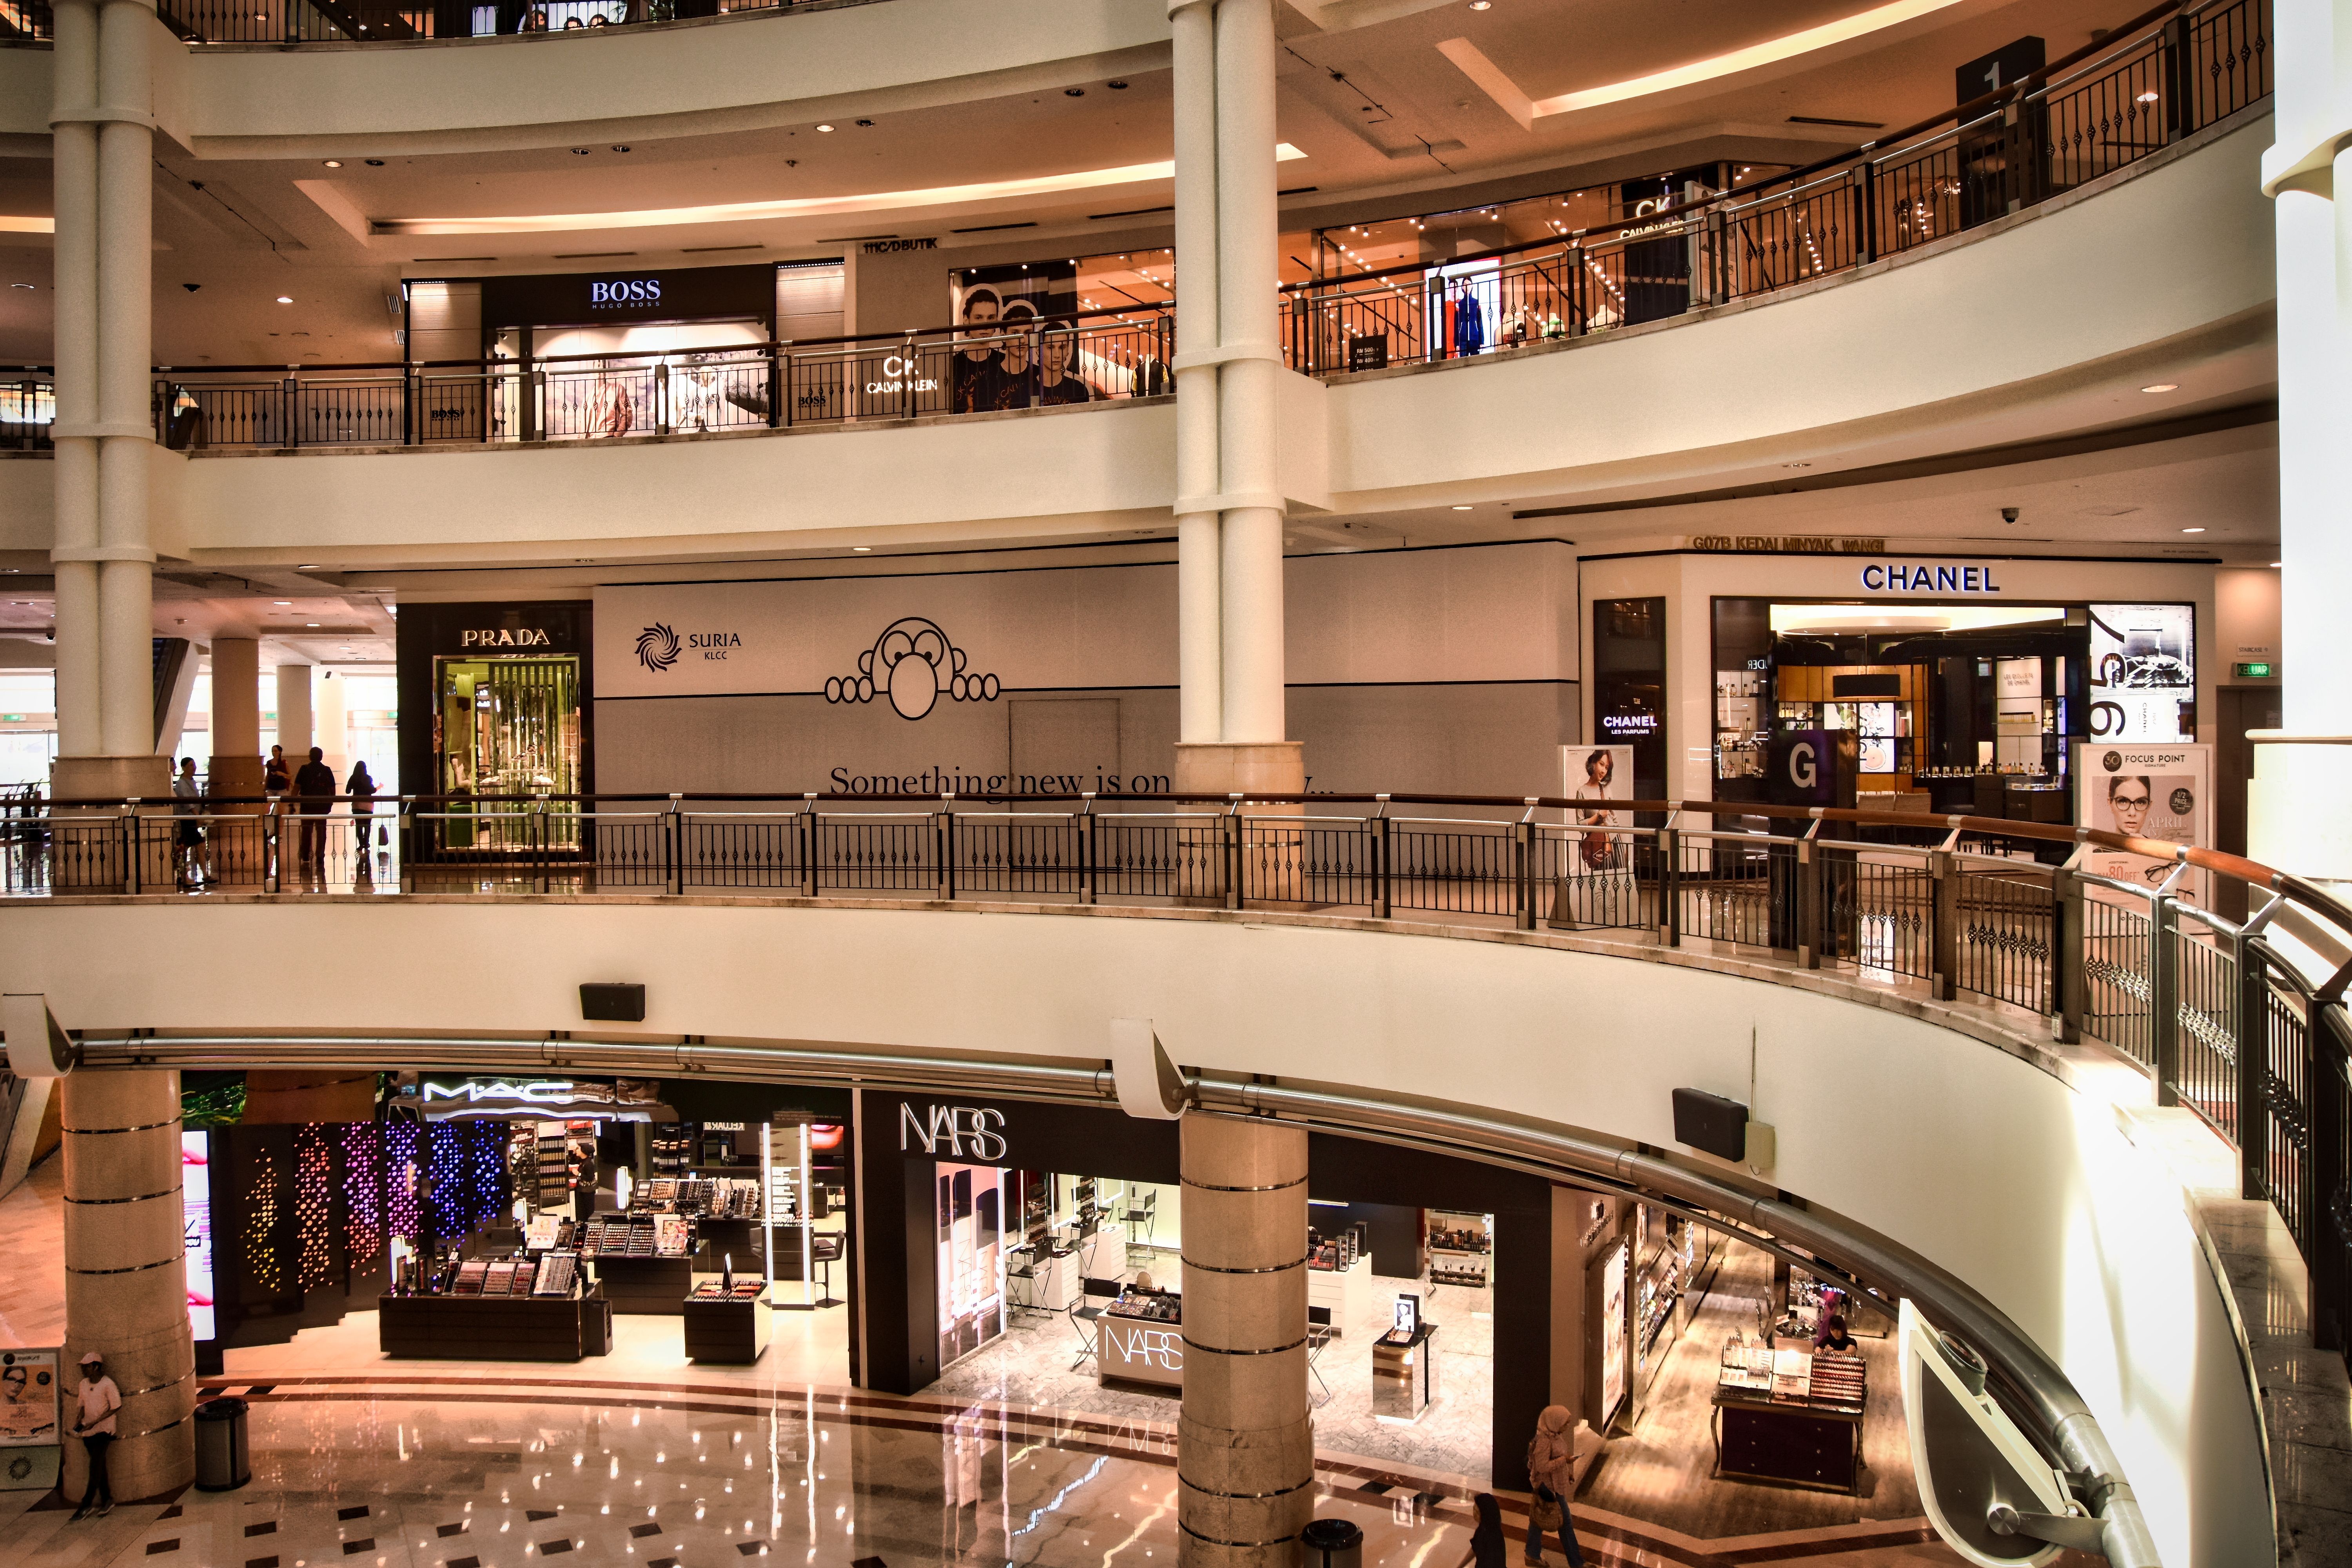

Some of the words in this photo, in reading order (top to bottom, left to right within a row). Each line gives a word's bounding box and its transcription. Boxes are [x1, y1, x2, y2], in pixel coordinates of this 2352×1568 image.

[1984, 61, 2000, 104] 1
[592, 280, 661, 302] BOSS
[867, 381, 903, 394] CALVIN
[798, 396, 826, 405] BOSS
[432, 410, 460, 418] BOSS
[1693, 536, 1731, 550] G07B
[1736, 537, 1779, 550] KEDAI
[1782, 537, 1836, 552] MINYAK
[1842, 539, 1885, 553] WANGI
[1862, 564, 2000, 592] CHANEL
[461, 628, 550, 646] PRADA
[689, 633, 742, 648] SURIA
[705, 651, 728, 660] KLCC
[2238, 665, 2268, 675] KELUAR
[1603, 716, 1658, 727] CHANEL
[1789, 742, 1816, 788] G
[831, 766, 1007, 804] Something
[1019, 775, 1083, 793] new
[1096, 765, 1120, 793] is
[1131, 775, 1170, 793] on
[2149, 816, 2187, 828] APRIL
[2109, 866, 2123, 880] 80
[901, 1102, 1006, 1160] NARS
[1105, 1325, 1182, 1370] NARS
